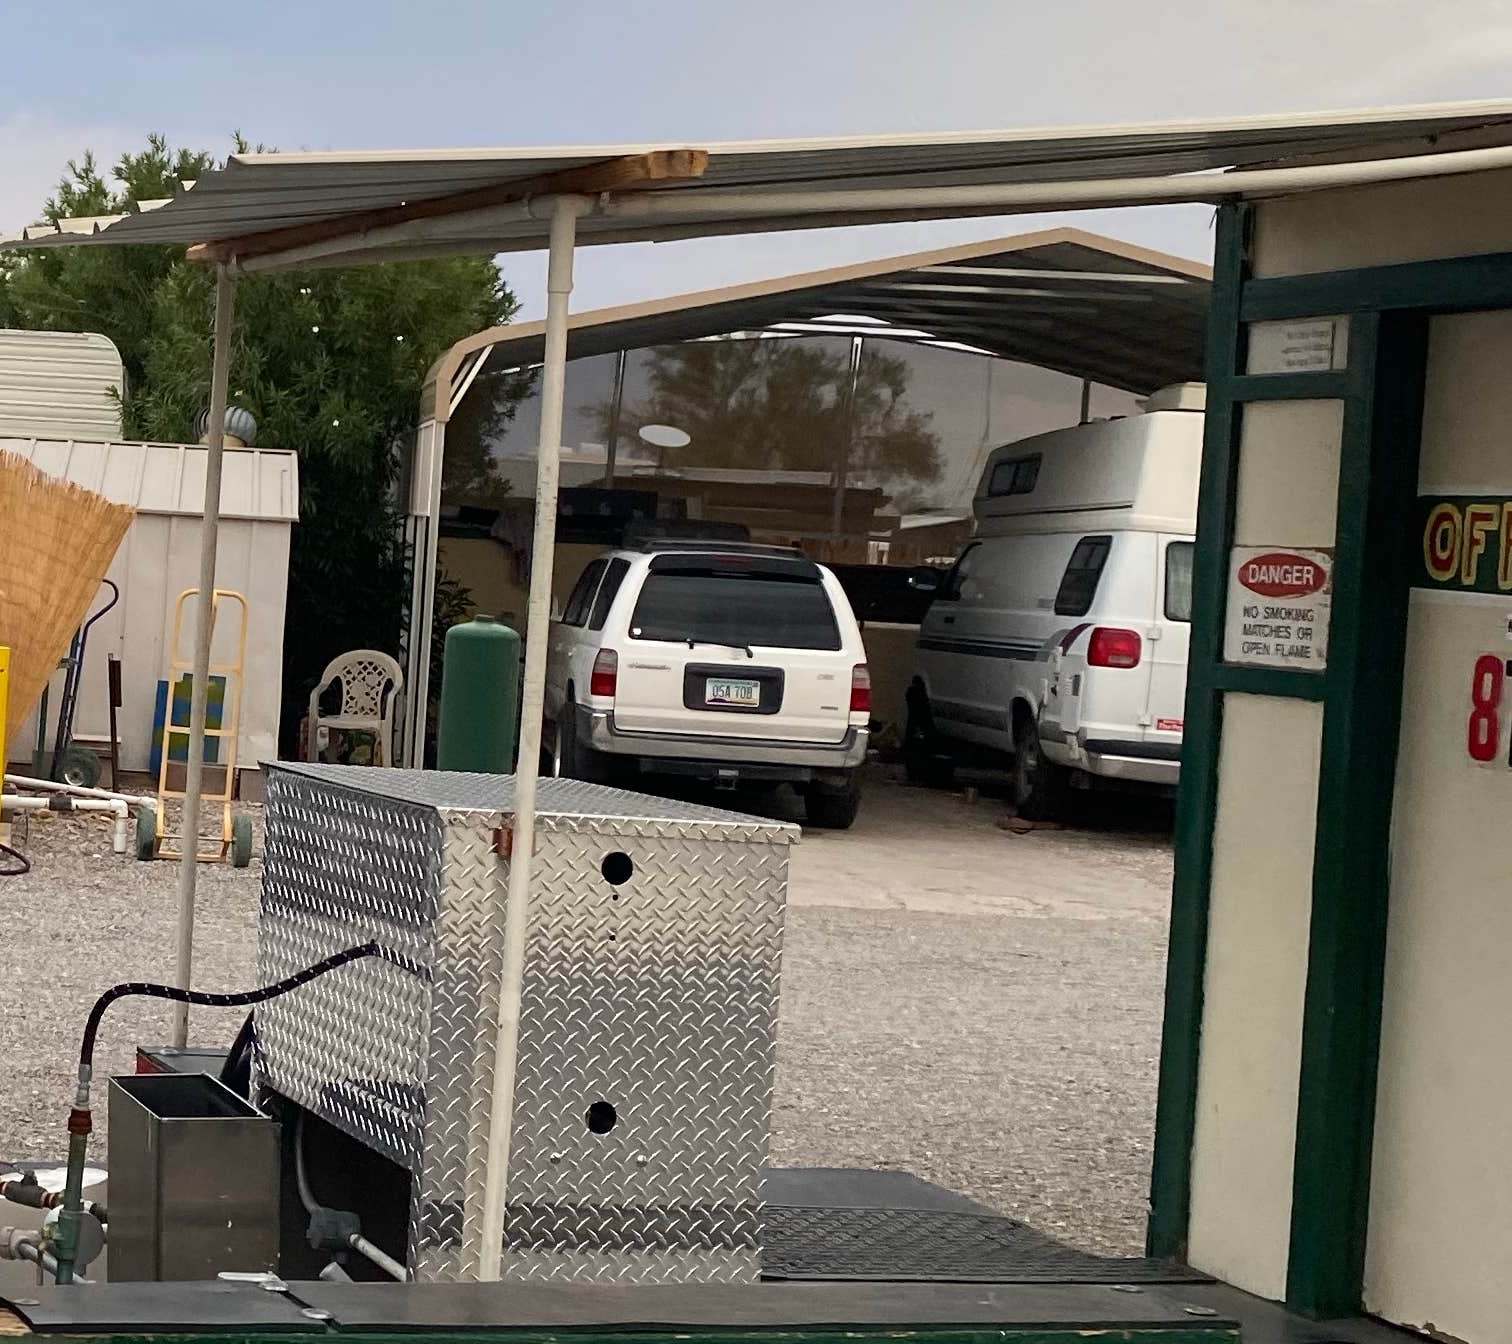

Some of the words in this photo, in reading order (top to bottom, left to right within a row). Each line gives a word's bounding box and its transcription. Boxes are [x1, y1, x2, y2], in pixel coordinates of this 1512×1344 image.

[1248, 564, 1315, 586] DANGER
[1243, 605, 1259, 619] NO
[1263, 607, 1314, 622] SMOKING
[1242, 623, 1291, 639] MATCHES
[1296, 626, 1313, 641] OR
[1241, 641, 1271, 656] OPEN
[1275, 643, 1311, 659] FLAME
